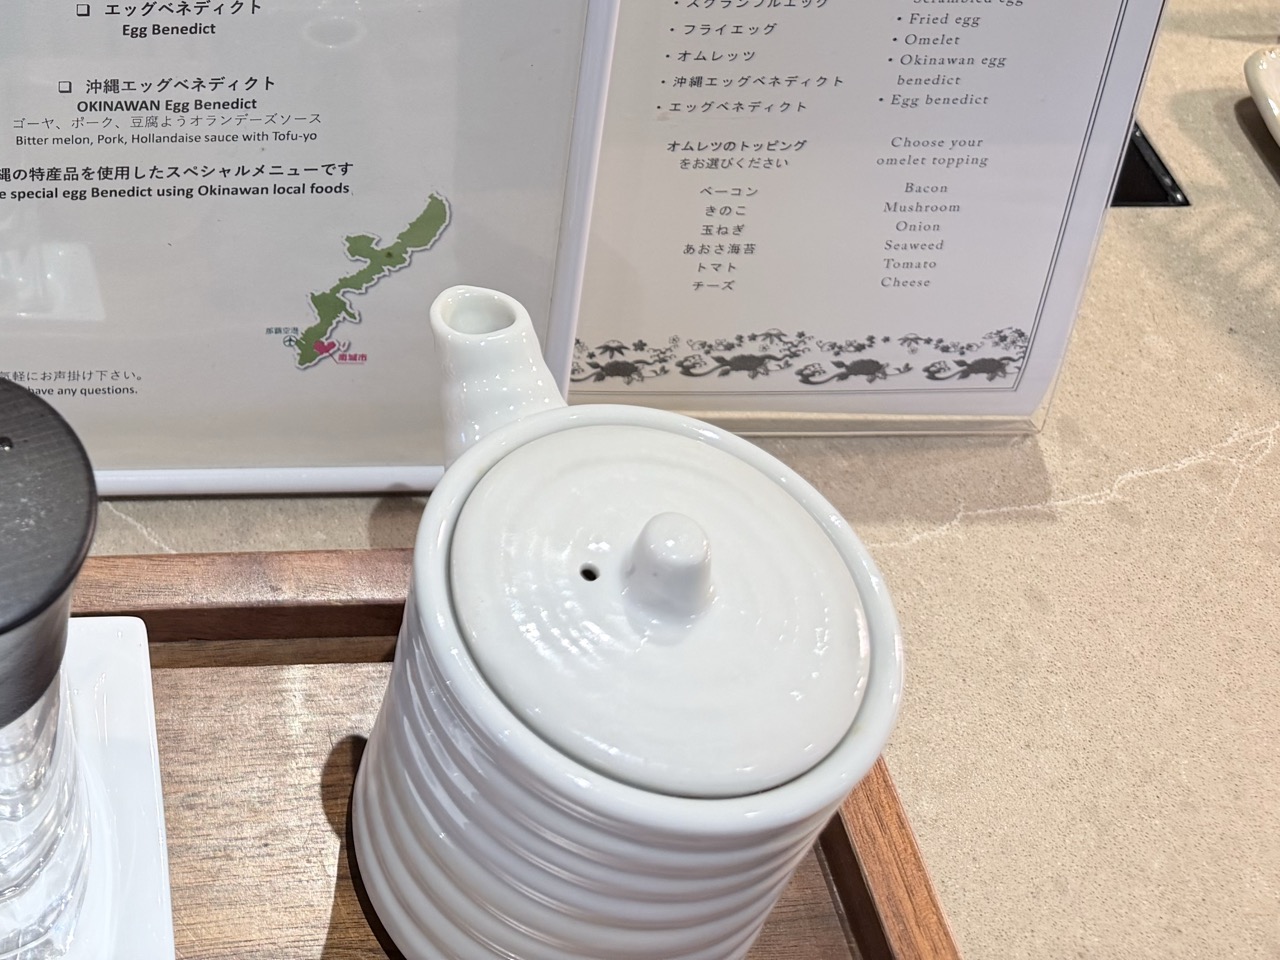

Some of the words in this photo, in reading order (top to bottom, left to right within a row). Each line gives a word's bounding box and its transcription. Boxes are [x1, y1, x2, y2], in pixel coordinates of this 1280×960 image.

[105, 0, 260, 17] エッグベネディクト
[910, 13, 949, 24] Fried
[955, 17, 980, 27] egg
[123, 25, 147, 38] Egg
[152, 23, 216, 35] Benedict
[685, 23, 777, 35] フライエッグ
[905, 34, 960, 45] Omelet
[678, 50, 755, 62] オムレッツ
[900, 54, 974, 65] Okinawan
[981, 58, 1006, 68] egg
[86, 76, 274, 94] 沖縄エッグベネディクト
[673, 76, 842, 88] 沖縄エッグベネディクト
[897, 74, 961, 85] benedict
[77, 100, 160, 112] OKINAWAN
[165, 100, 189, 113] Egg
[194, 98, 257, 110] Benedict
[669, 101, 806, 112] エッグベネディクト
[891, 94, 919, 108] Egg
[925, 94, 988, 104] benedict
[16, 136, 49, 145] Bitter
[53, 135, 93, 146] melon,
[98, 134, 127, 145] Pork,
[132, 133, 201, 143] Hollandaise
[205, 134, 238, 142] sauce
[242, 131, 268, 141] with
[272, 131, 317, 142] Tofu-yo
[891, 137, 944, 147] Choose
[949, 140, 983, 150] your
[667, 140, 807, 152] オムレツのトッピング
[680, 157, 788, 169] をお選びください
[877, 155, 926, 165] omelet
[932, 155, 988, 168] topping
[11, 187, 58, 201] special
[63, 190, 87, 200] egg
[92, 186, 152, 197] Benedict
[157, 186, 193, 198] using
[198, 185, 268, 196] Okinawan
[273, 183, 305, 194] local
[700, 187, 758, 196] ベーコン
[905, 182, 947, 193] Bacon
[706, 205, 745, 216] きのこ
[884, 202, 960, 212] Mushroom
[701, 224, 744, 236] 玉ねぎ
[896, 221, 940, 231] Onion
[683, 243, 756, 255] あおさ海苔
[884, 240, 944, 250] Seaweed
[698, 262, 736, 272] トマト
[884, 258, 936, 269] Tomato
[693, 280, 735, 291] チーズ
[881, 277, 930, 287] Cheese
[58, 388, 77, 397] any
[80, 386, 137, 396] questions.
